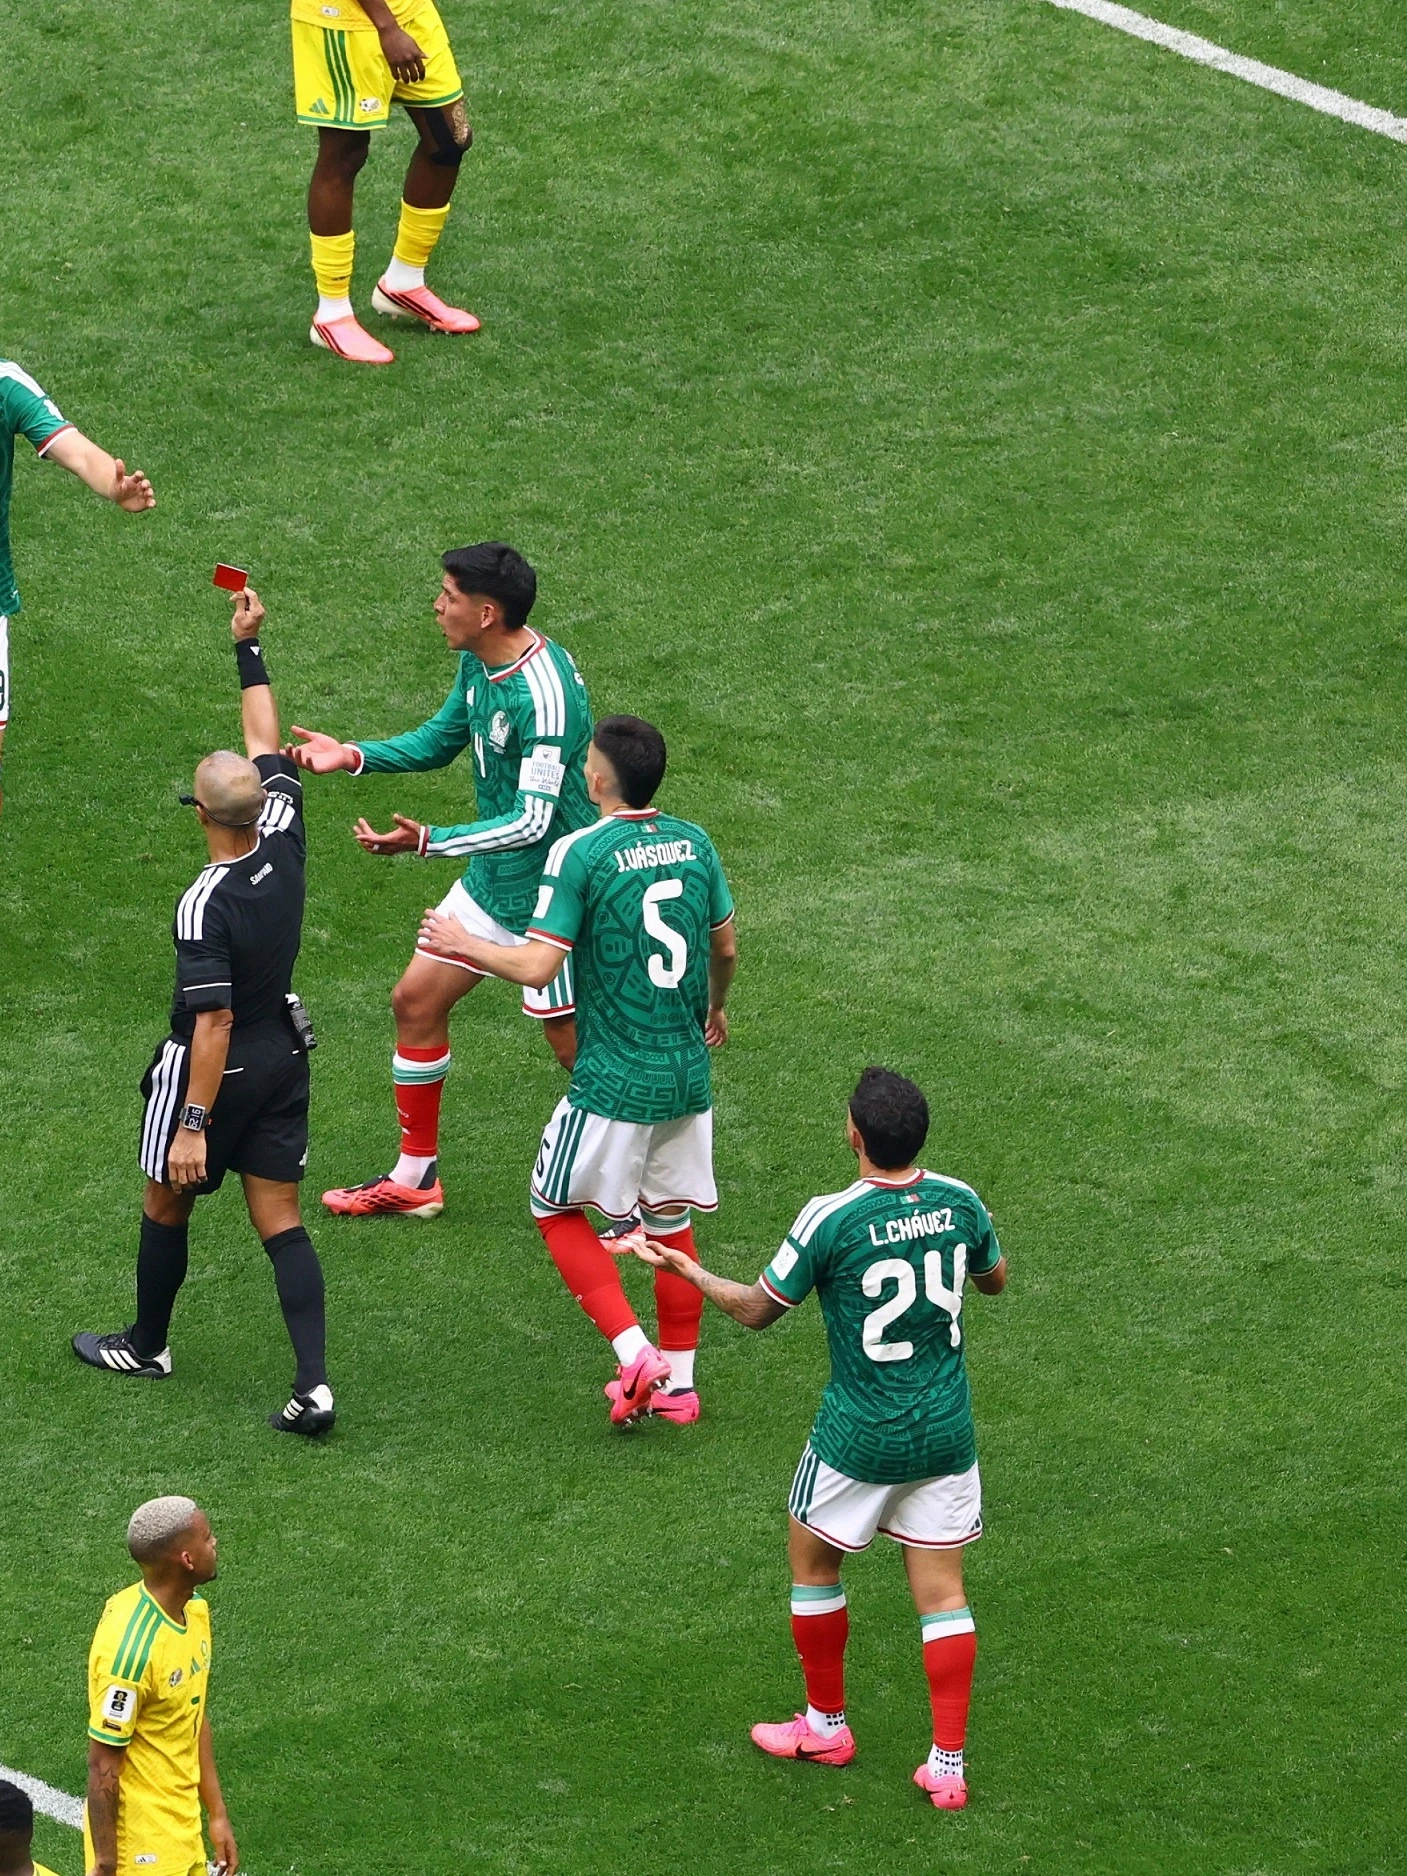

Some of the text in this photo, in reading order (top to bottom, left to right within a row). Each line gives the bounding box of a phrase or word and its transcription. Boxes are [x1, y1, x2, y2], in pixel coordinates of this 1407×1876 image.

[531, 767, 560, 780] UNITES
[614, 839, 697, 873] J.VÁSQUEZ
[642, 878, 688, 989] 5
[868, 1207, 956, 1247] L.CHÁVEZ
[861, 1242, 968, 1363] 24
